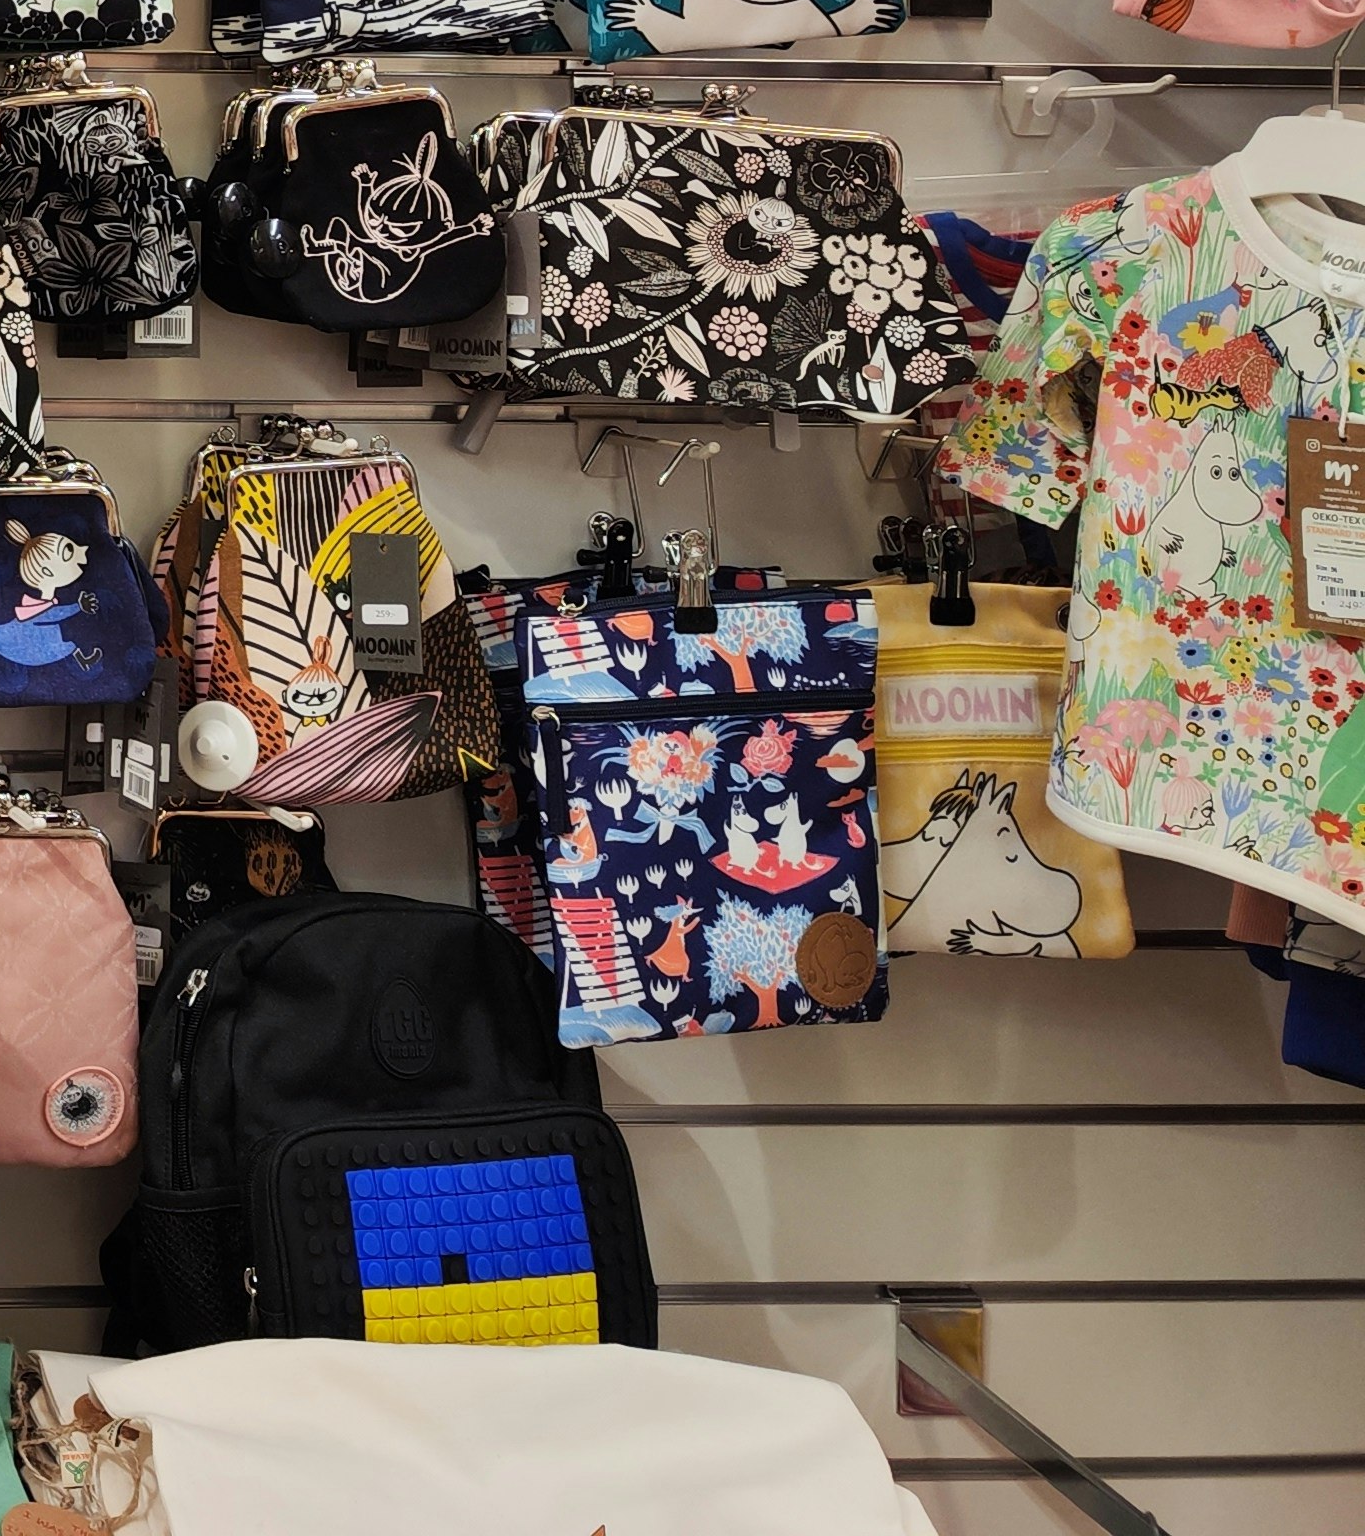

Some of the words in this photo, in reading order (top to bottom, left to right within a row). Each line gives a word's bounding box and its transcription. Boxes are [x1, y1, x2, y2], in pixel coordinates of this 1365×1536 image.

[10, 235, 37, 277] MOOMIN
[435, 338, 503, 357] MOOMIN
[354, 636, 416, 657] MOOMIN
[895, 686, 1035, 726] MOOMIN
